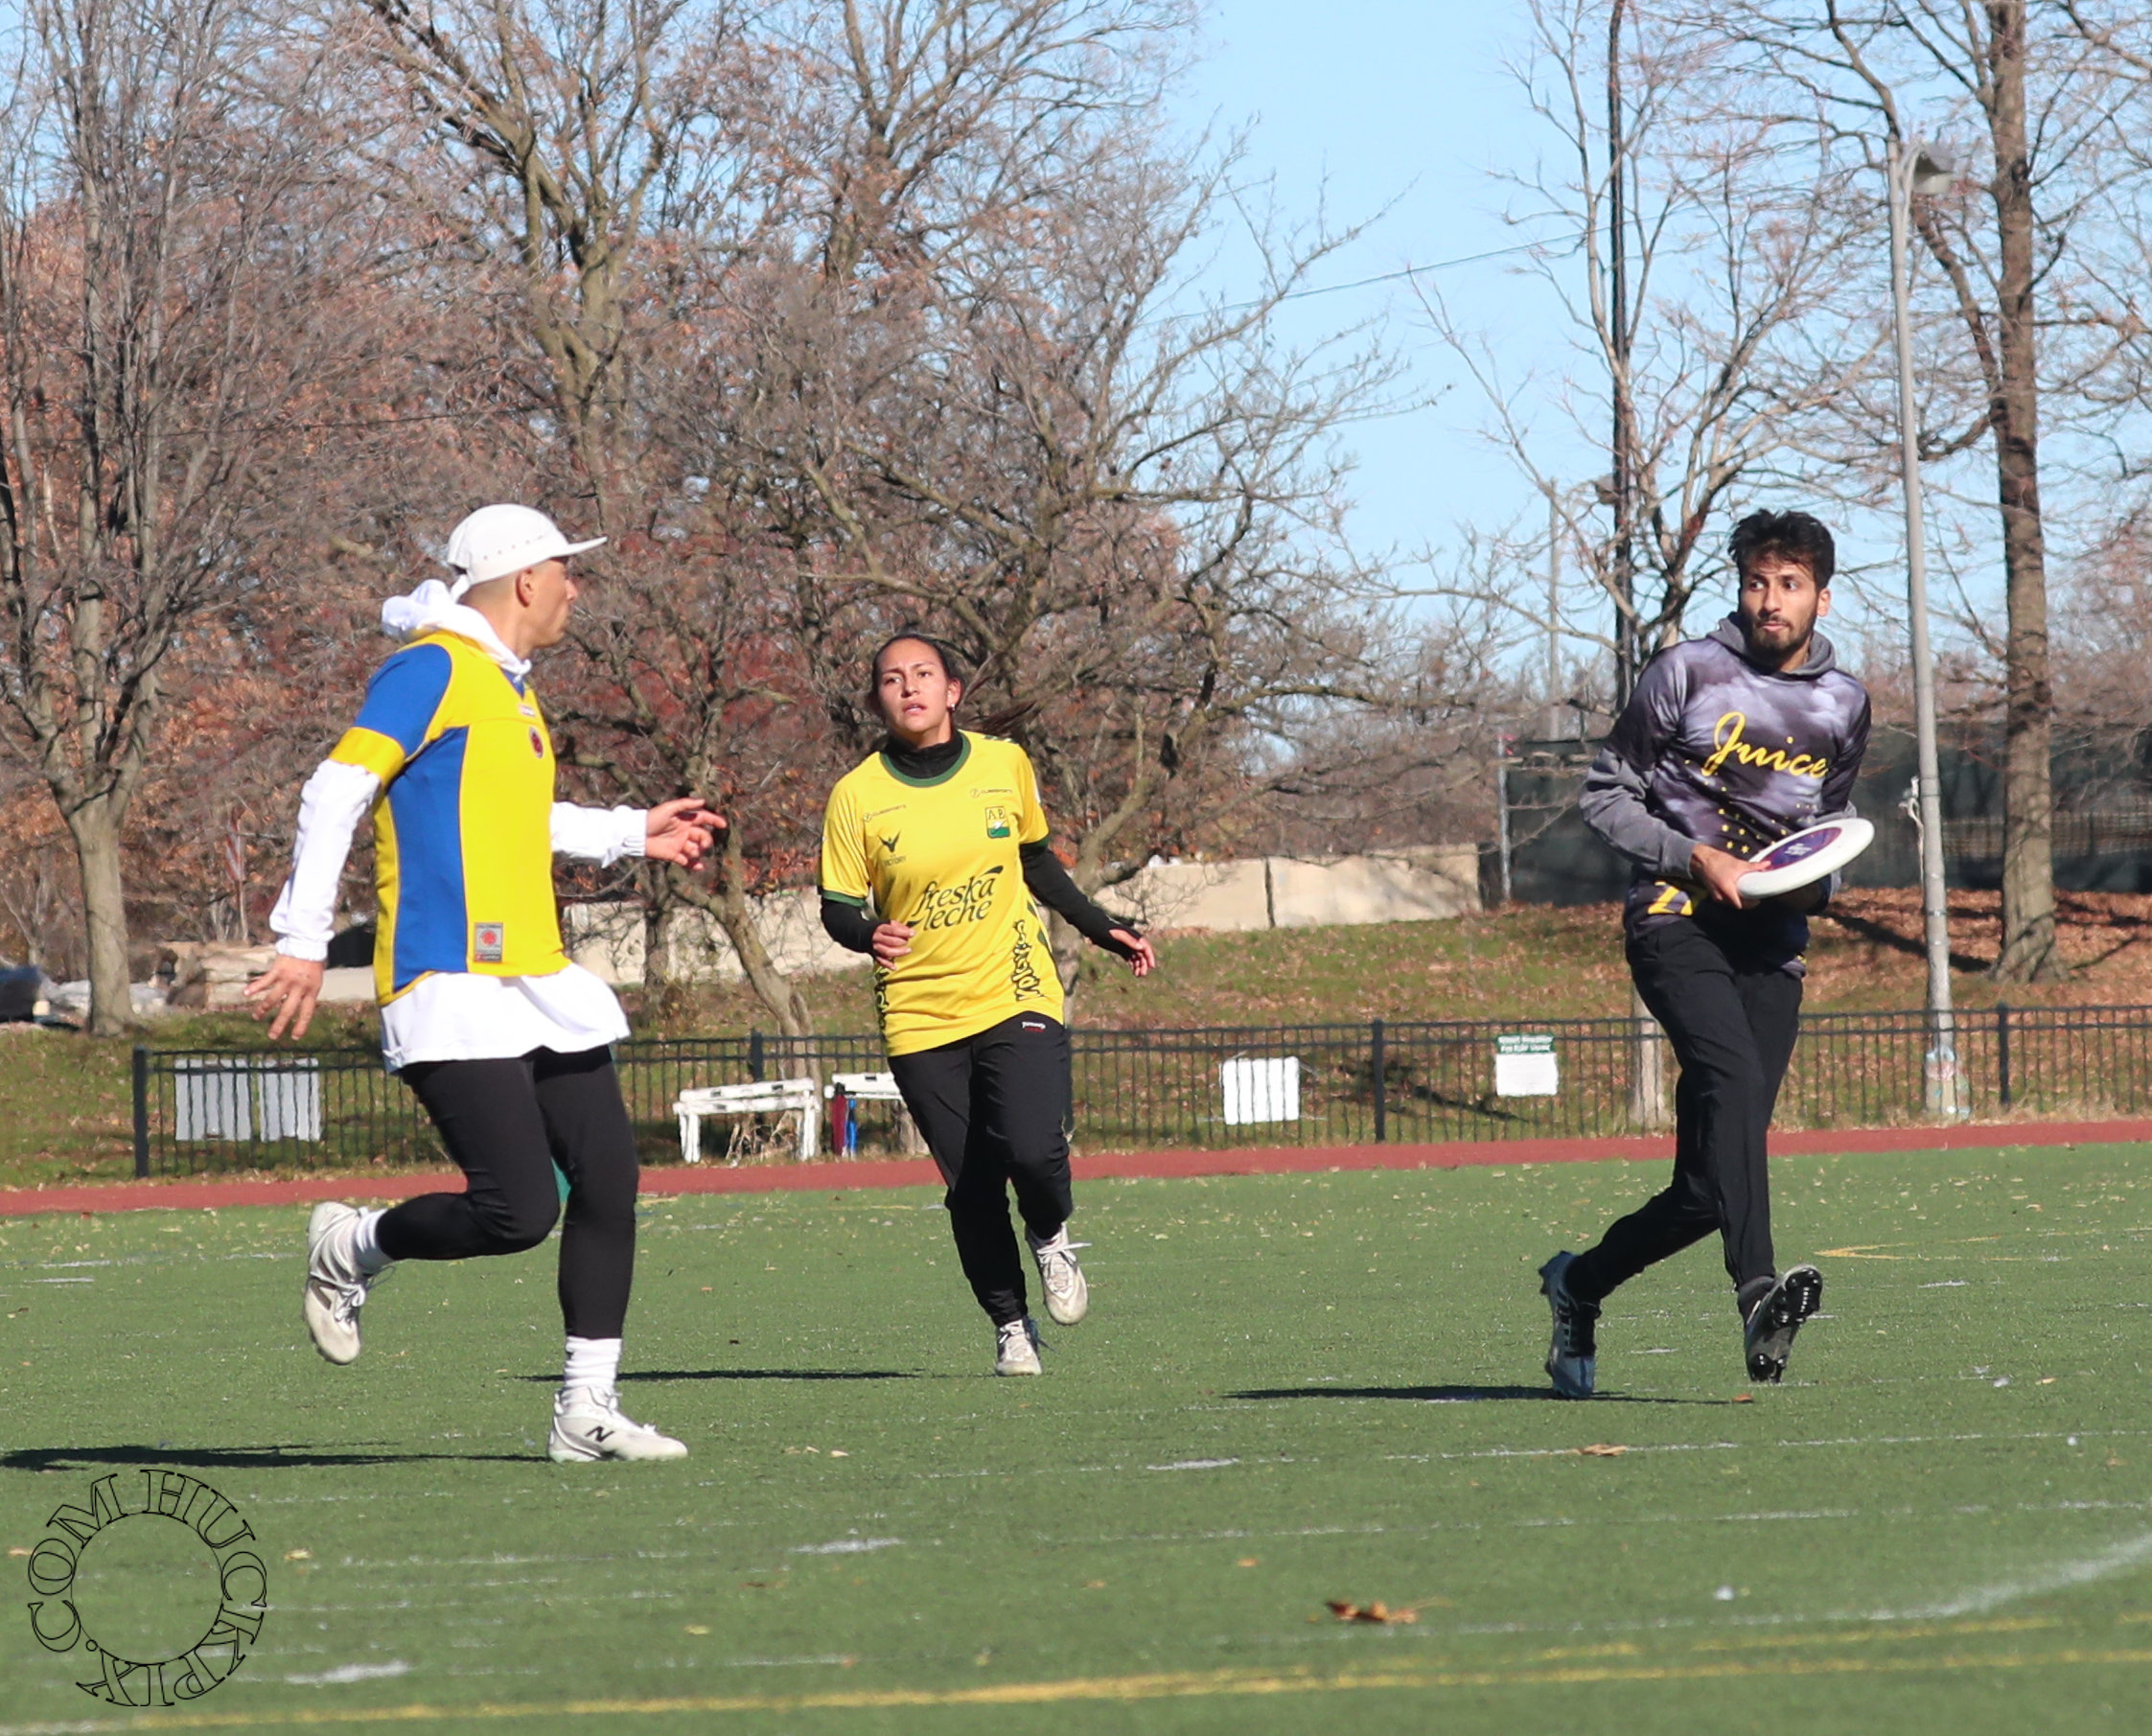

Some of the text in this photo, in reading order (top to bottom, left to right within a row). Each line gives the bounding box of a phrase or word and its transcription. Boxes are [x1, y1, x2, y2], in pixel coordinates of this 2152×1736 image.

[1701, 711, 1828, 778] Juice
[911, 875, 997, 917] freska
[922, 898, 992, 931] leche
